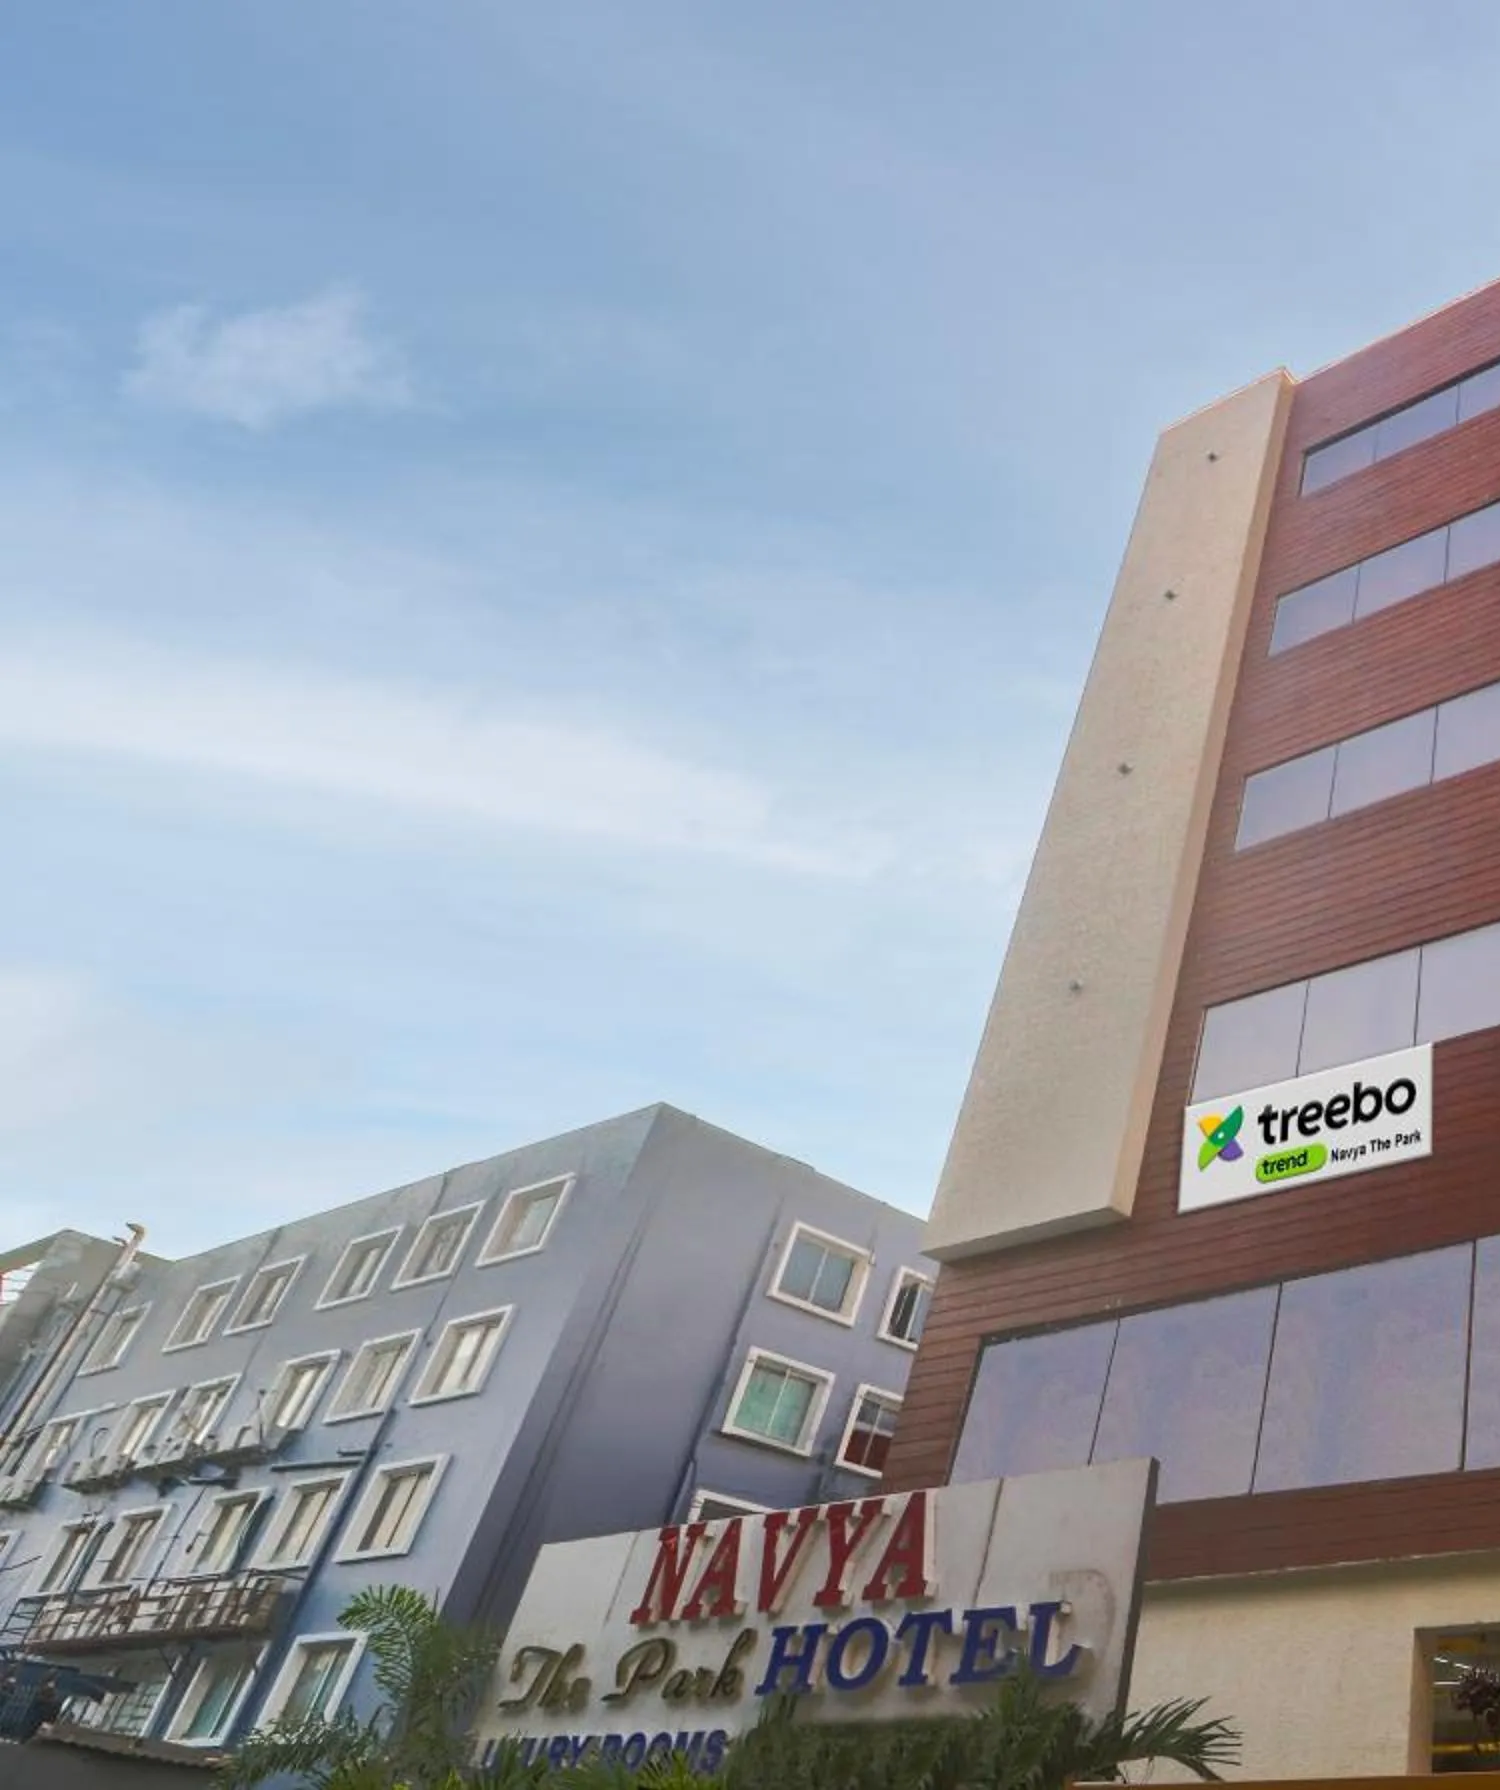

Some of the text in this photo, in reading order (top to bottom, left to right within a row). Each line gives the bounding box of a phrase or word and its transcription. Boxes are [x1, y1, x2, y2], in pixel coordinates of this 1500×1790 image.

[1258, 1078, 1417, 1144] treebo
[1262, 1149, 1308, 1174] trend
[1331, 1130, 1421, 1163] Navya The Park
[630, 1491, 928, 1624] NAVYA
[498, 1600, 1081, 1709] The Park HOTEL
